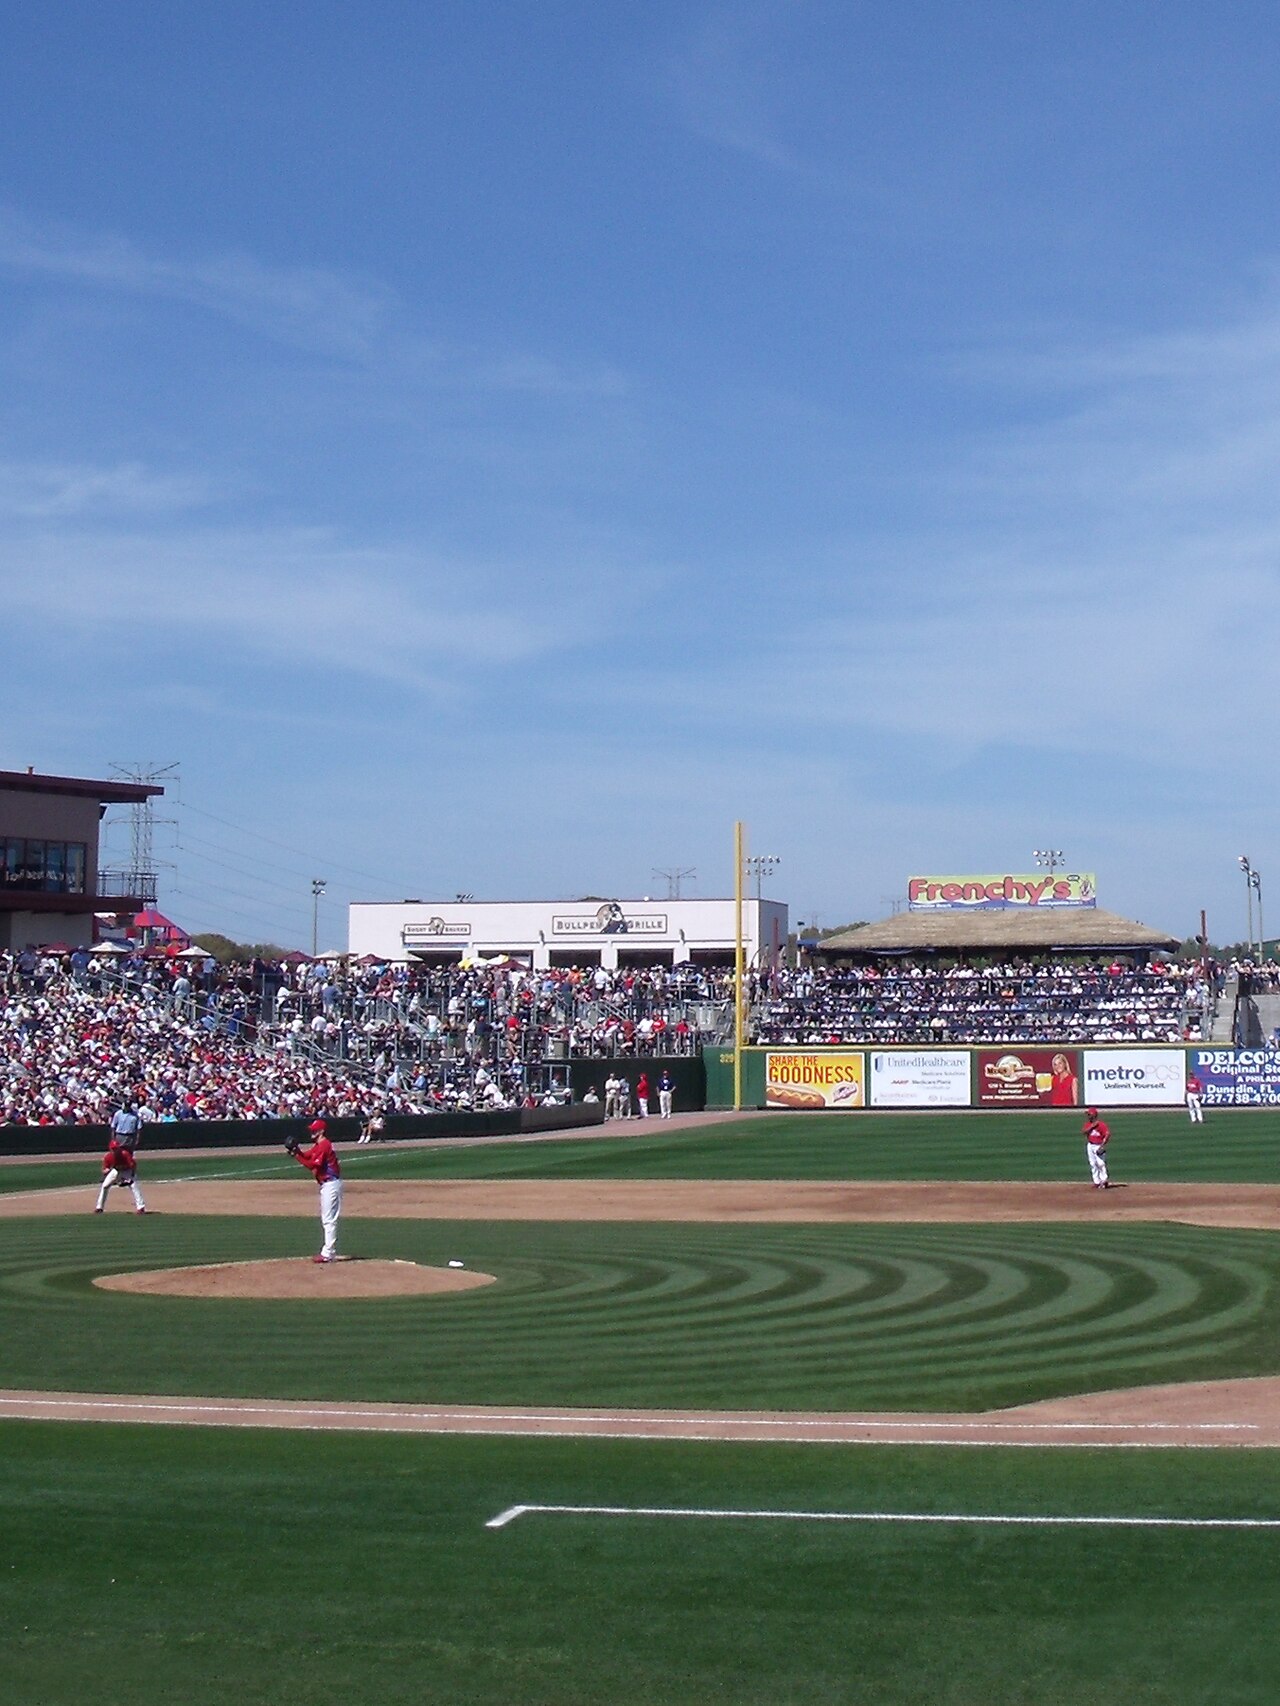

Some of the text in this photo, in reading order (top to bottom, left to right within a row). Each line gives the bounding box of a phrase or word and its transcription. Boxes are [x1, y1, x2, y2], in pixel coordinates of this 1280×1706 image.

[909, 876, 1072, 905] Frenchy's
[769, 1055, 819, 1066] SHARE THE
[888, 1057, 967, 1068] UnitedHealthcare
[768, 1066, 859, 1084] GOODNESS.
[1088, 1065, 1180, 1081] metroPCS
[1211, 1064, 1260, 1076] Original
[1207, 1084, 1274, 1095] Dunedin, FL
